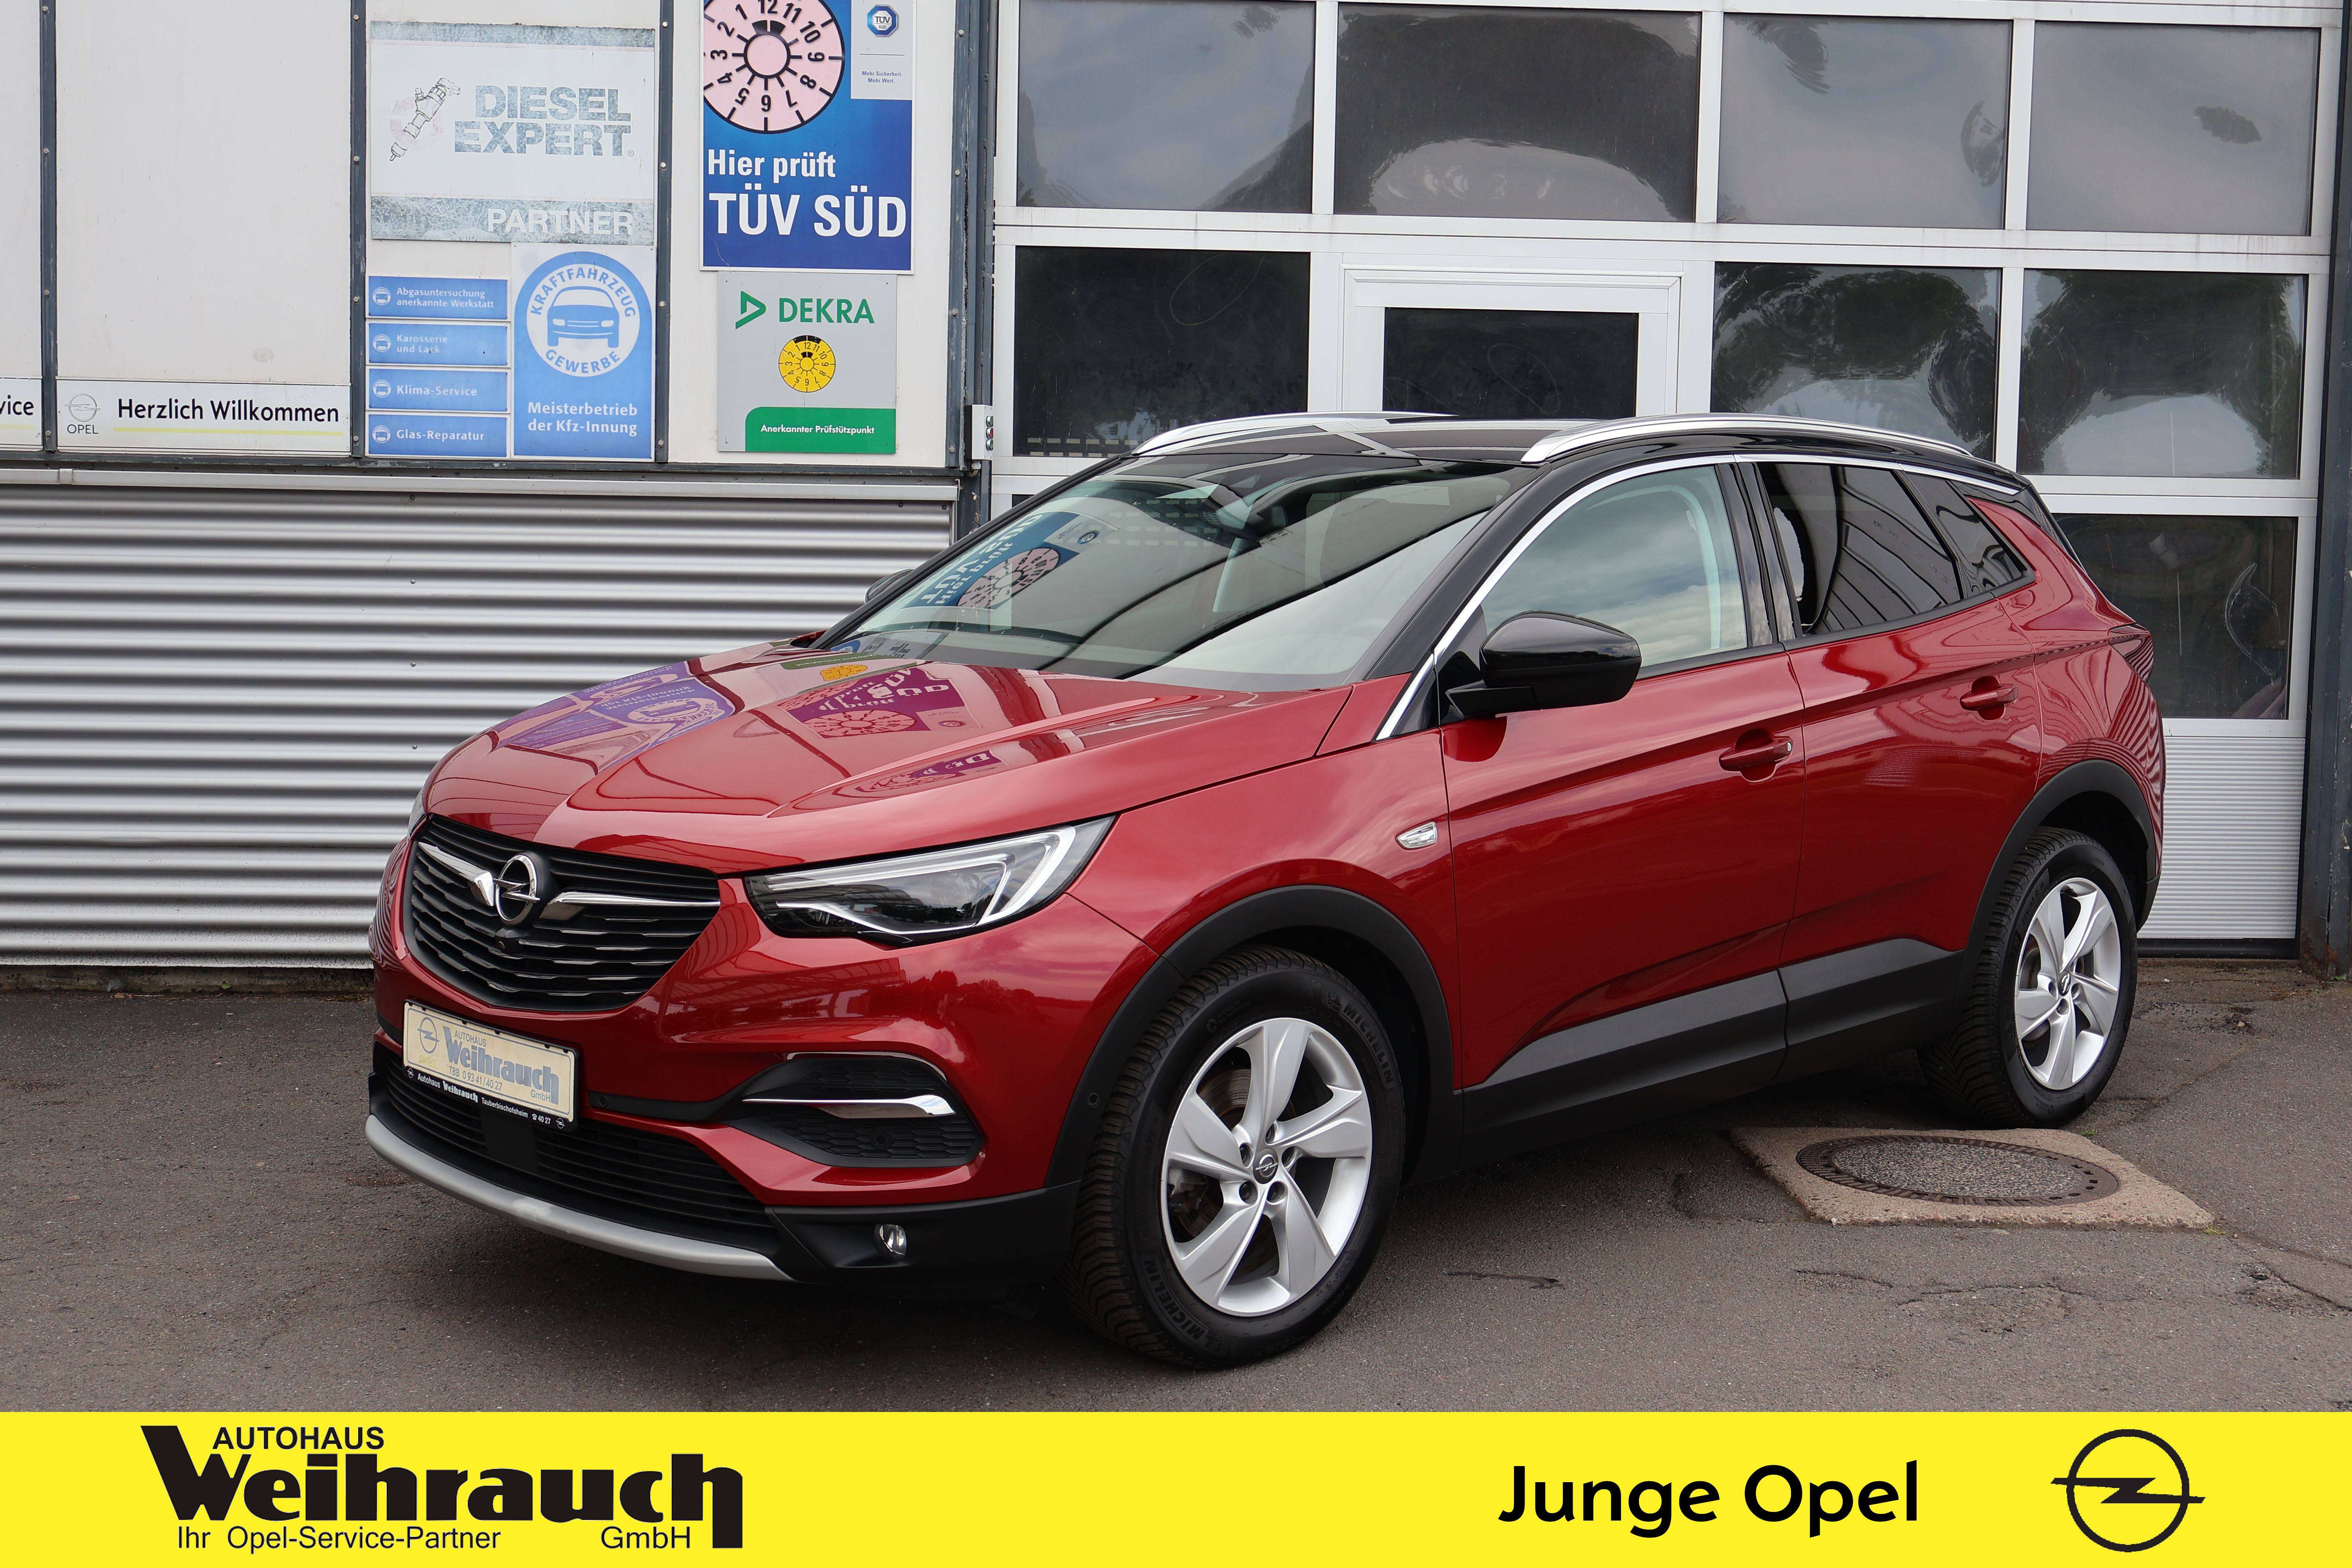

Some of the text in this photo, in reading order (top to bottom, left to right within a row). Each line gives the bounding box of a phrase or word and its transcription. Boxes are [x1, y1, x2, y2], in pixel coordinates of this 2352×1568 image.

[735, 4, 748, 20] 1
[758, 0, 778, 14] 12
[782, 2, 802, 24] 11
[717, 21, 735, 37] 2
[800, 20, 821, 44] 10
[710, 50, 728, 60] 3
[717, 72, 732, 85] 4
[800, 74, 817, 90] 8
[475, 84, 632, 122] DIESEL
[734, 87, 750, 105] 5
[785, 90, 798, 108] 7
[454, 120, 632, 157] EXPERT
[708, 149, 836, 183] Hier prüft
[709, 183, 906, 237] TÜV SÜD
[487, 208, 633, 236] PARTNER
[396, 287, 485, 299] Abgasuntersuchung
[530, 267, 636, 317] KRAFTFAHRZEUG
[396, 298, 494, 309] anerkannte Werkstatt
[779, 298, 875, 324] DEKRA
[396, 334, 448, 344] Karosserie
[418, 345, 440, 354] Lack
[813, 344, 820, 352] 11
[818, 351, 827, 359] 10
[545, 349, 621, 374] GEWERBE
[397, 385, 477, 397] Klima-Service
[118, 397, 339, 422] Herzlich Willkommen
[528, 402, 637, 417] Meisterbetrieb
[67, 424, 99, 435] OPEL
[396, 429, 485, 442] Glas-Reparatur
[528, 419, 637, 437] der Kfz-Innung
[760, 425, 875, 436] Anerkannter Prüfstützpunkt
[454, 1030, 486, 1047] AUTOHAUS
[1343, 1003, 1394, 1084] MICHELIN
[443, 1025, 559, 1105] Weihrauch
[449, 1066, 460, 1077] TBB
[463, 1071, 466, 1079] 0
[467, 1072, 474, 1082] 93
[495, 1081, 503, 1091] 27
[417, 1073, 440, 1088] Autohaus
[443, 1081, 478, 1103] Weihrauch
[481, 1098, 528, 1118] Tauberbischofsheim
[531, 1089, 550, 1102] GmbH
[1144, 1259, 1207, 1340] MICHELIN
